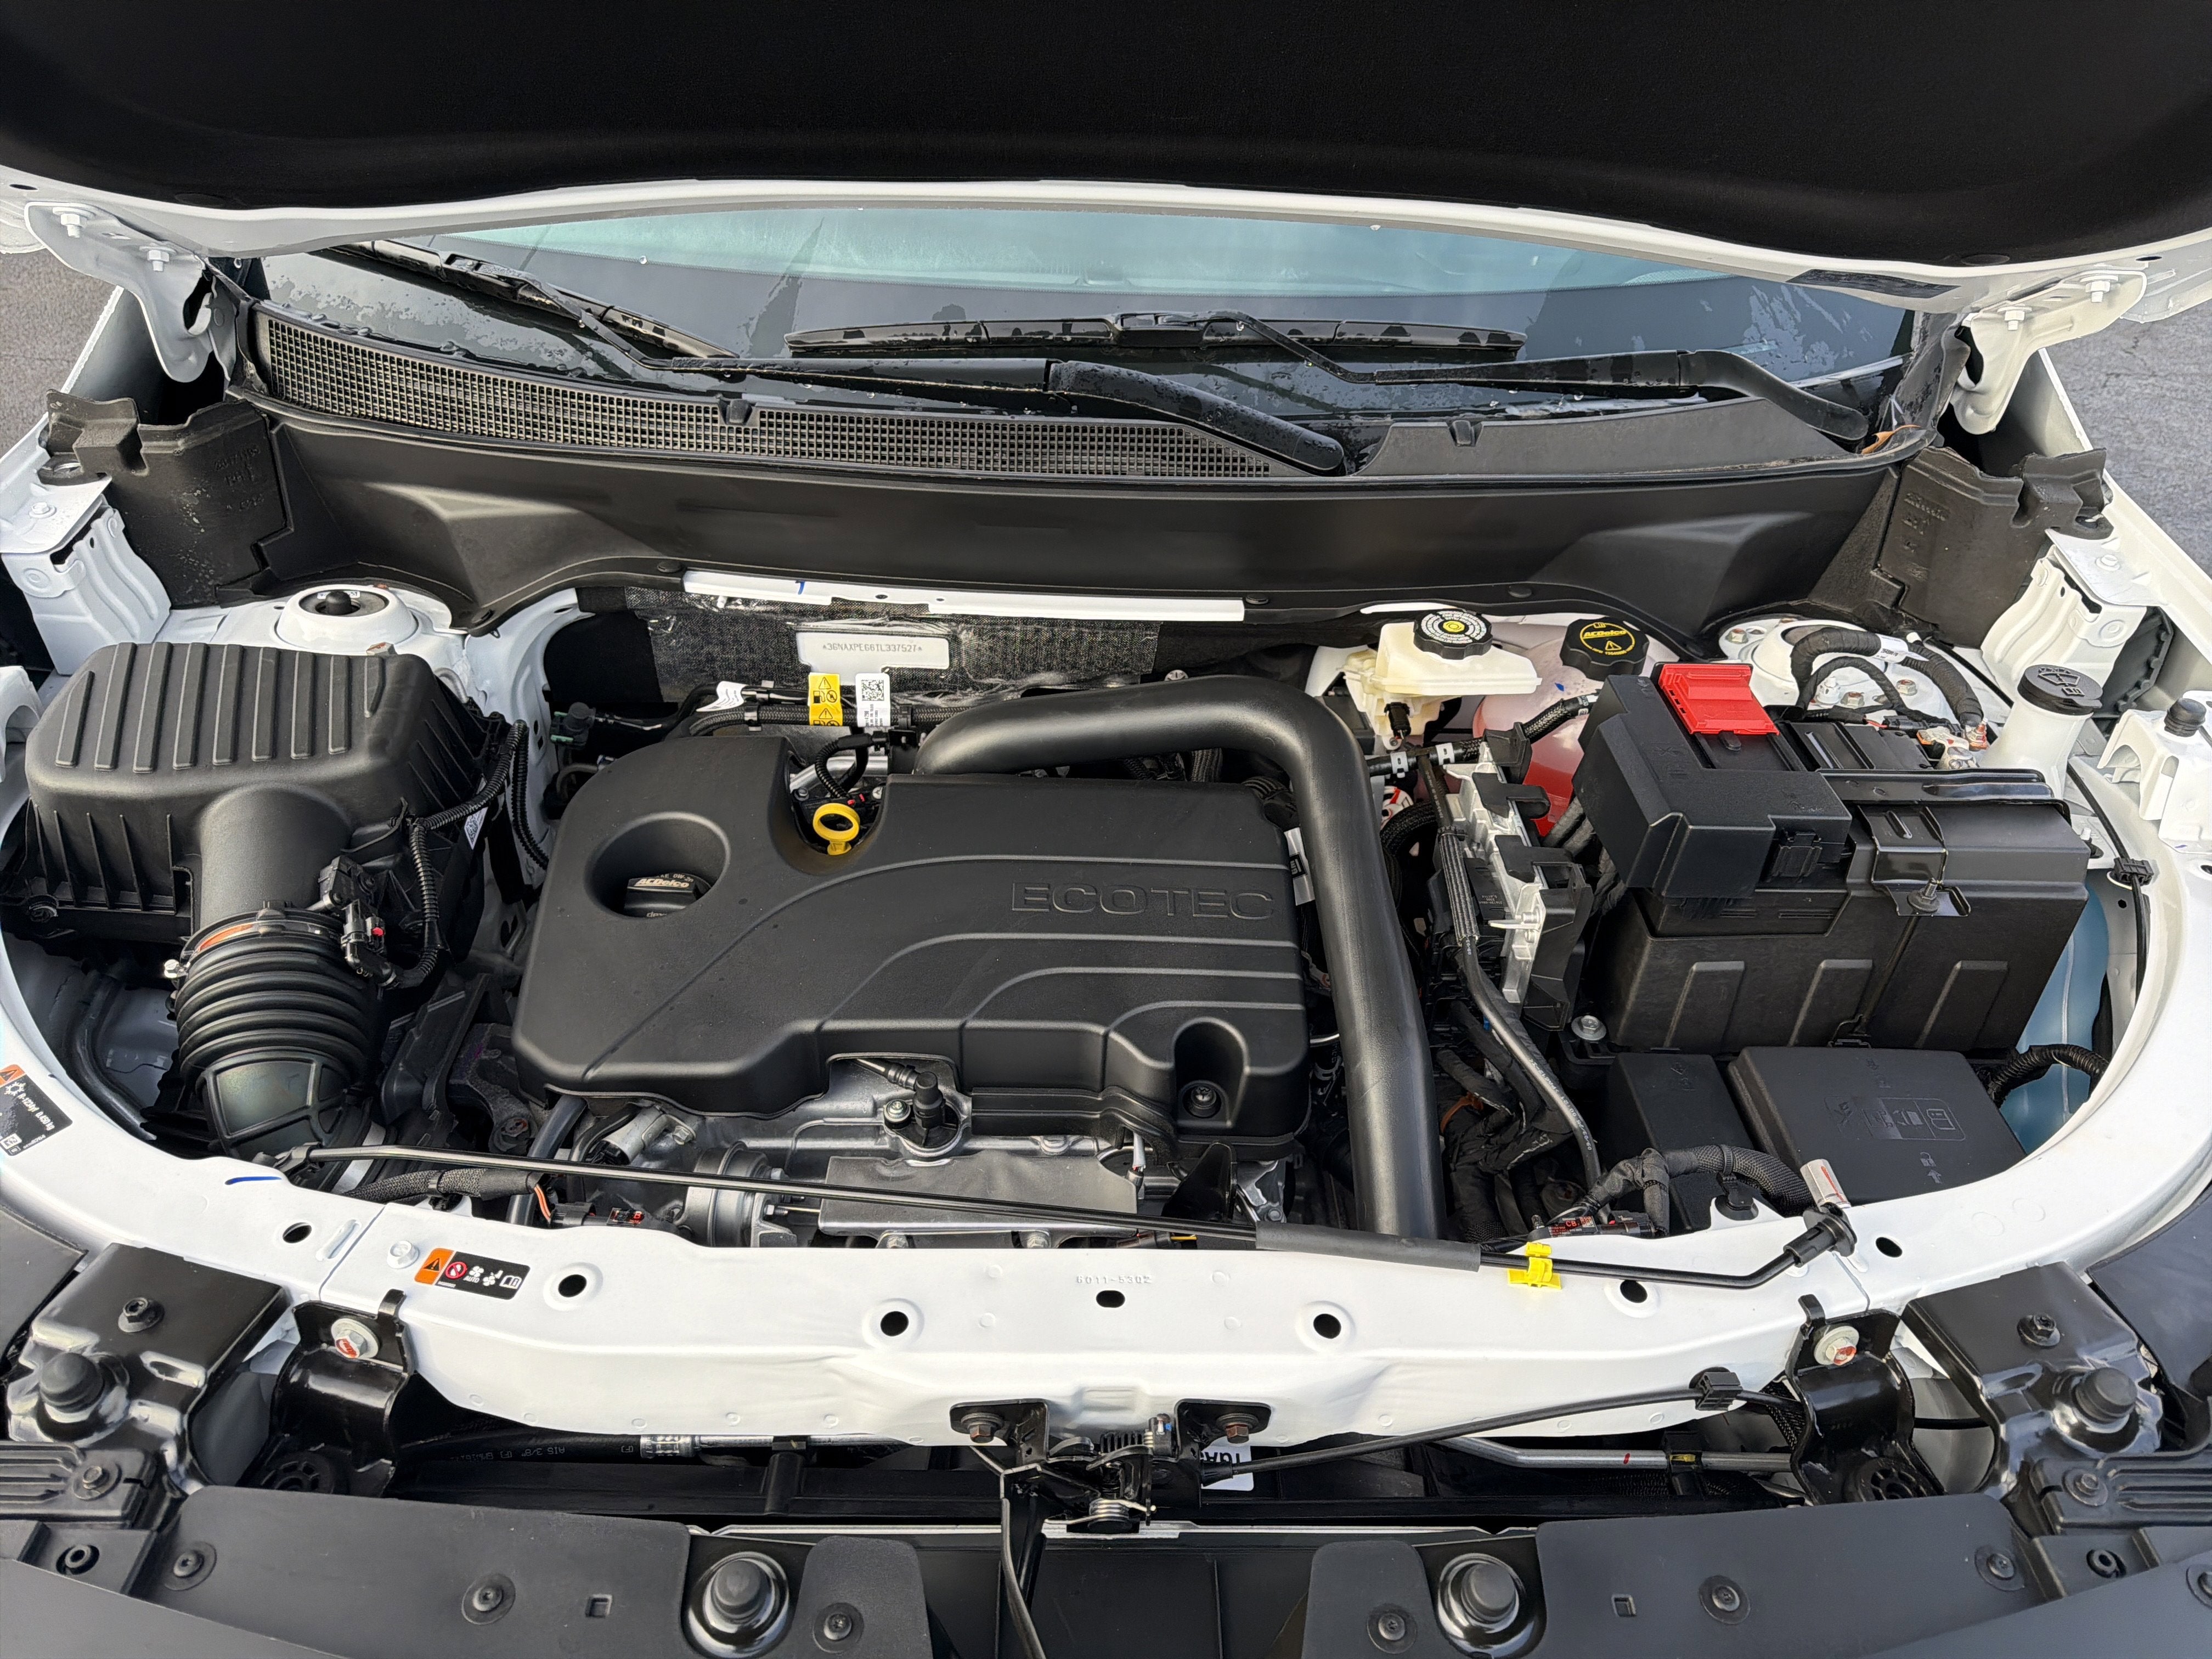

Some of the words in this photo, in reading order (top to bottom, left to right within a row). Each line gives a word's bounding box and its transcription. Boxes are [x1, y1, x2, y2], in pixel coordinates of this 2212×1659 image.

[635, 878, 690, 888] ACDelco
[1012, 882, 1274, 919] ECOTEC
[462, 1275, 480, 1283] AUTO
